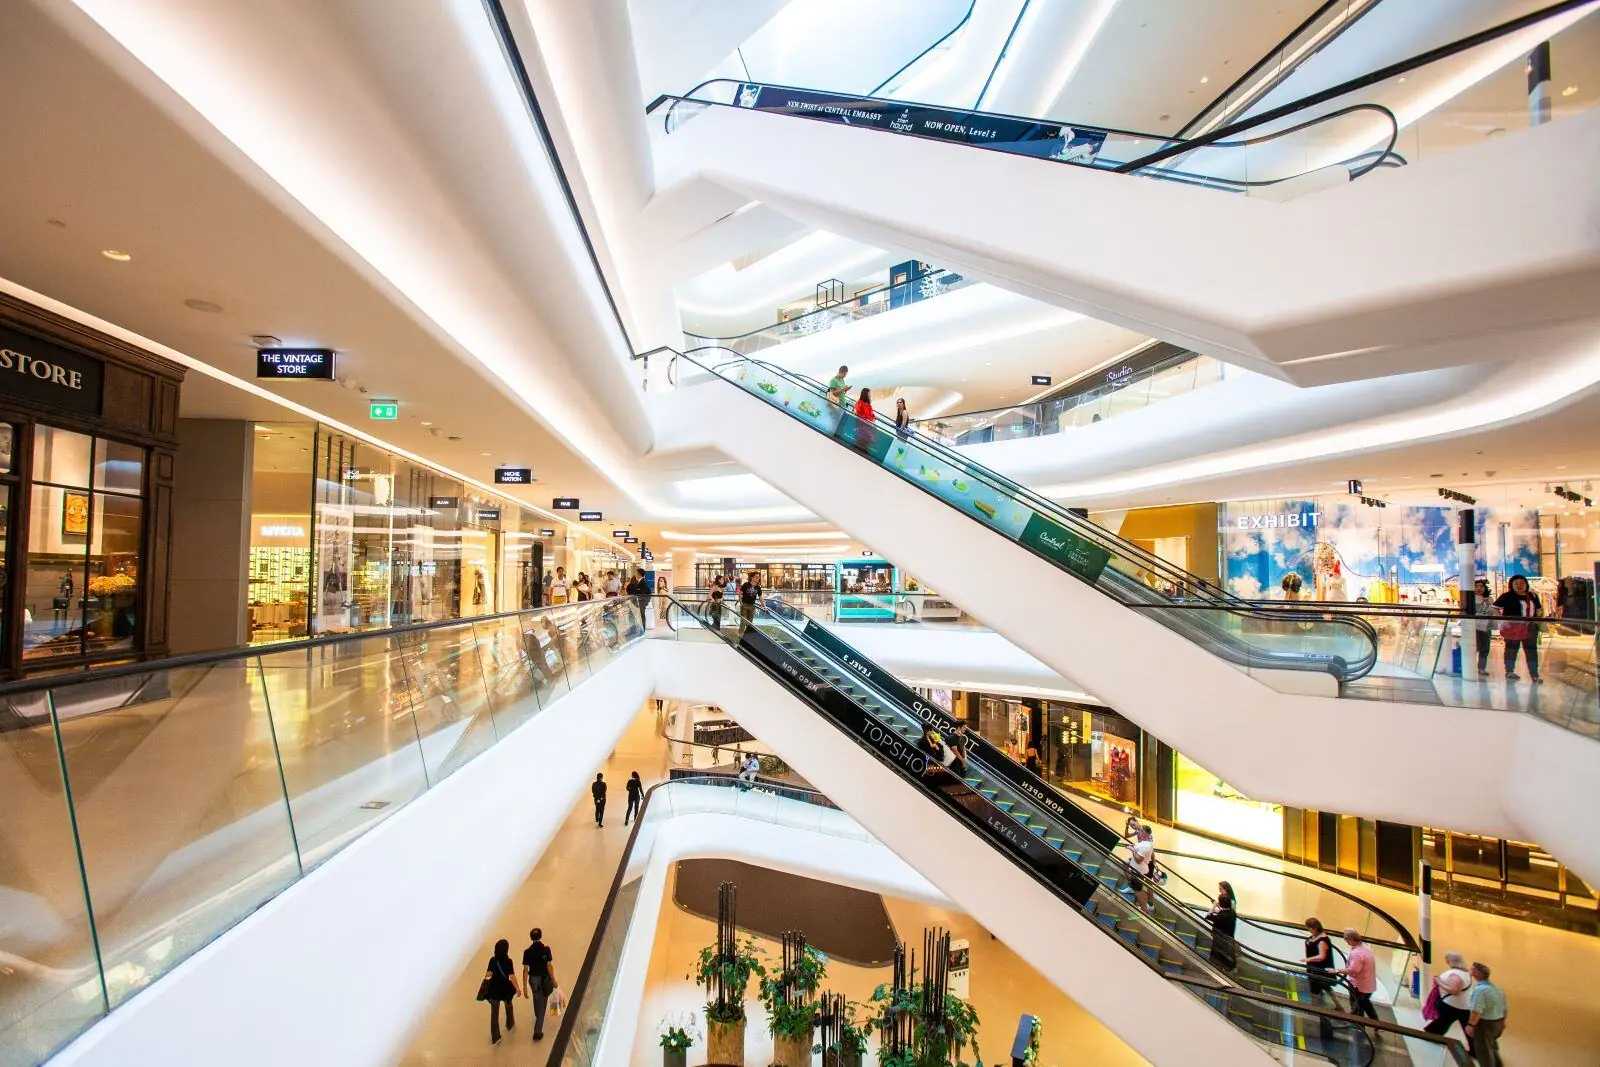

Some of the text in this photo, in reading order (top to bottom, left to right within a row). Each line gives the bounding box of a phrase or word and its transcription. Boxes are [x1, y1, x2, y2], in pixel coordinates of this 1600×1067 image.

[787, 100, 800, 108] NEW
[800, 102, 817, 110] TWIST
[824, 106, 850, 116] CENTRAL
[852, 110, 882, 120] EMBASSY
[890, 120, 914, 131] hound
[924, 120, 944, 130] NOW
[944, 123, 966, 135] OPEN,
[969, 128, 989, 138] Level
[261, 354, 323, 363] THE VINTAGE
[0, 348, 82, 390] STORE
[277, 365, 307, 374] STORE
[1106, 366, 1133, 382] iStudio
[1238, 512, 1322, 529] EXHIBIT
[1040, 532, 1066, 549] Central
[782, 661, 819, 692] NOW OPEN
[987, 816, 1029, 849] LEVEL 3
